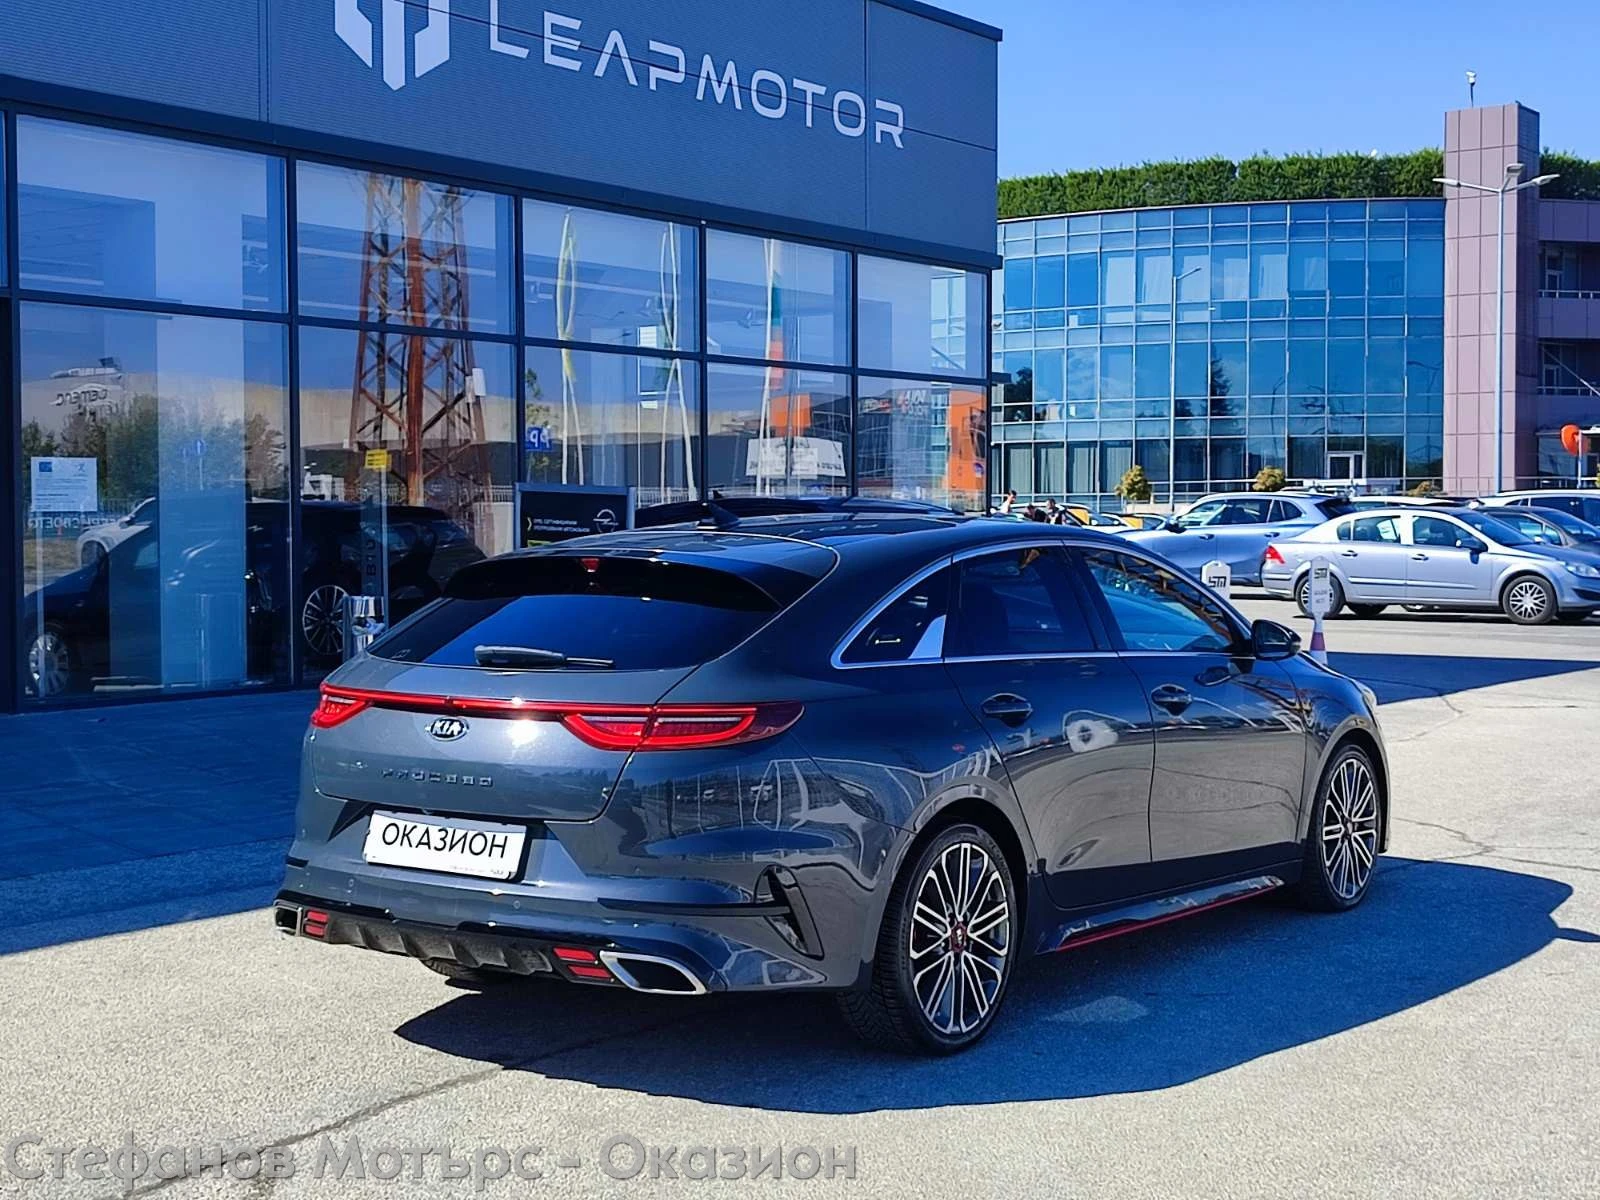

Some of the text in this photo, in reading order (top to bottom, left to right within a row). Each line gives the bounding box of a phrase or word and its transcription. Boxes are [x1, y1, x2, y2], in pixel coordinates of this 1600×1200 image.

[489, 0, 904, 149] LEAPMOTOR
[431, 720, 462, 736] KIA
[382, 822, 508, 859] ОКАЗИОН
